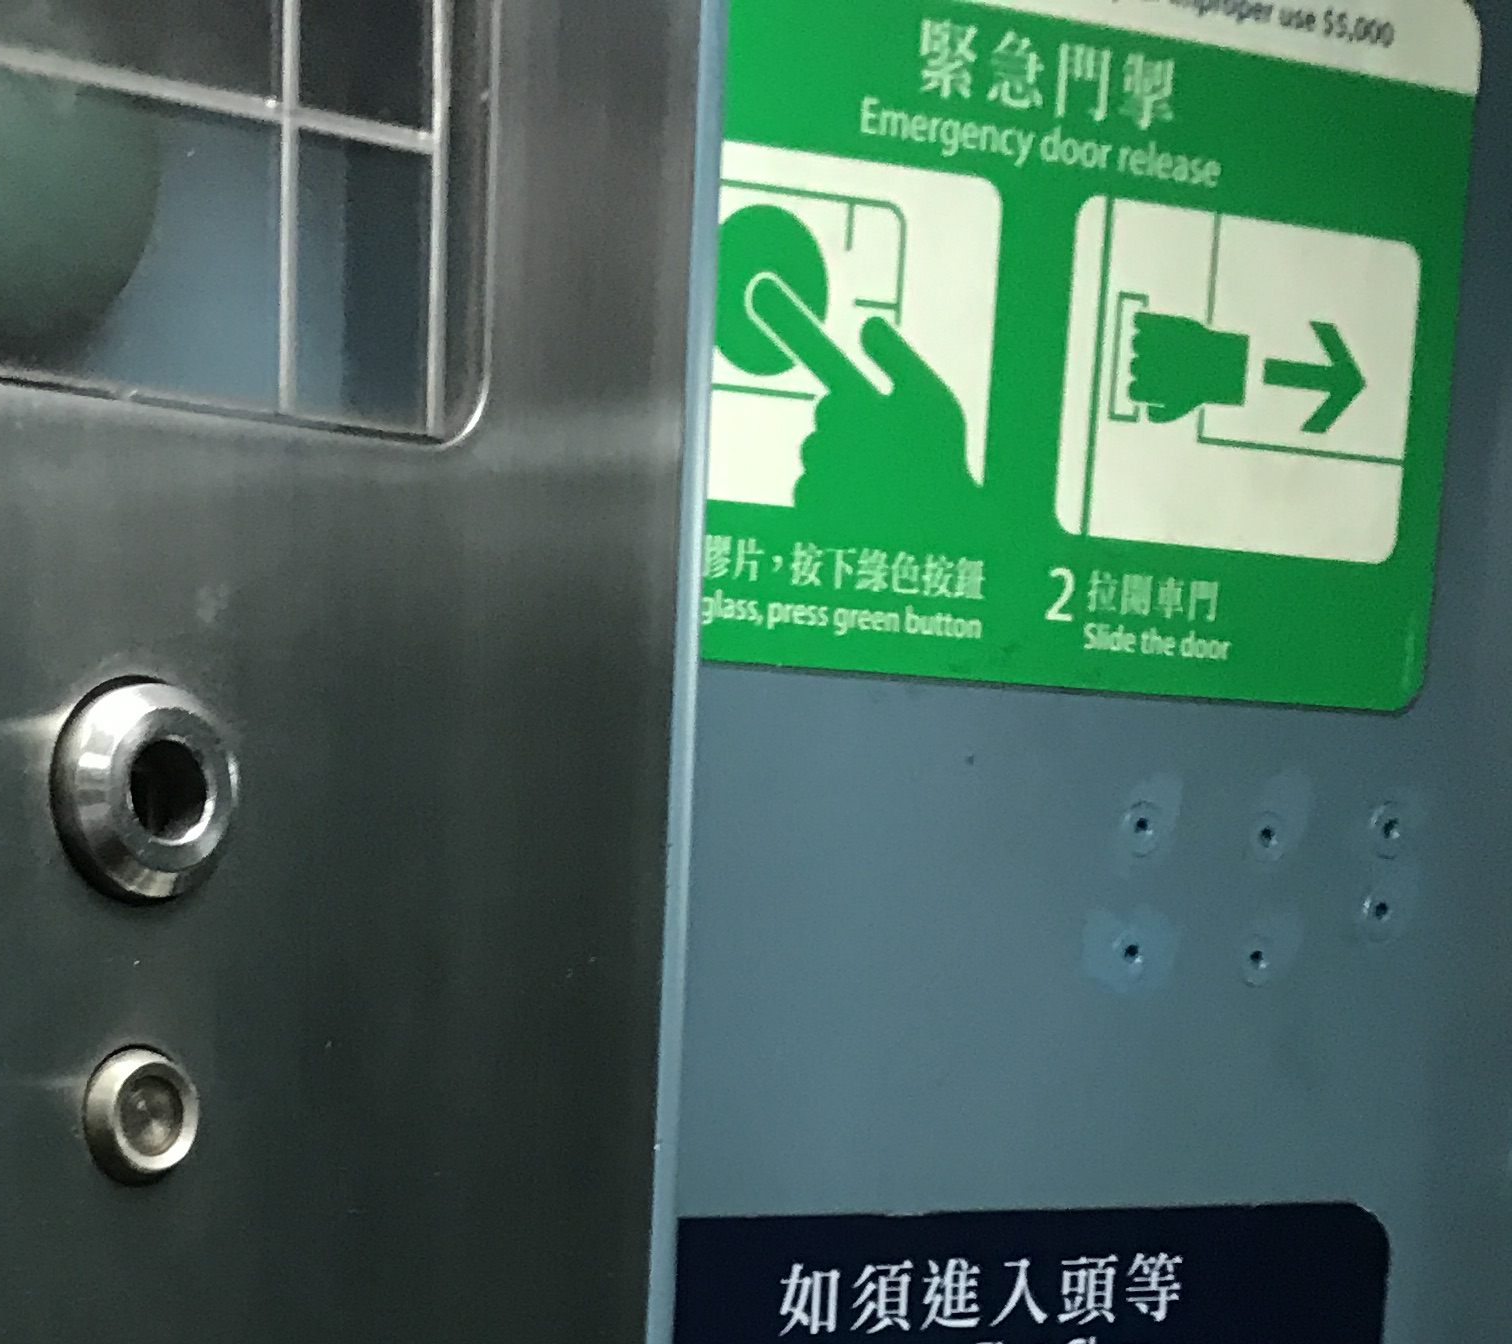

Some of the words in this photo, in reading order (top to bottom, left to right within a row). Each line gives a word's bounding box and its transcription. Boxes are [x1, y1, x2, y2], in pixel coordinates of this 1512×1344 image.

[1279, 9, 1316, 31] use
[860, 97, 1036, 167] Emergency
[1040, 126, 1113, 169] door
[1117, 141, 1222, 188] release
[701, 589, 764, 625] glass,
[767, 602, 828, 630] press
[833, 606, 900, 636] green
[904, 605, 982, 639] button
[1045, 566, 1075, 622] 2
[1084, 621, 1137, 653] Slide
[1140, 626, 1176, 656] the
[1180, 630, 1232, 660] door
[779, 1252, 1183, 1337] 如須進入頭等
